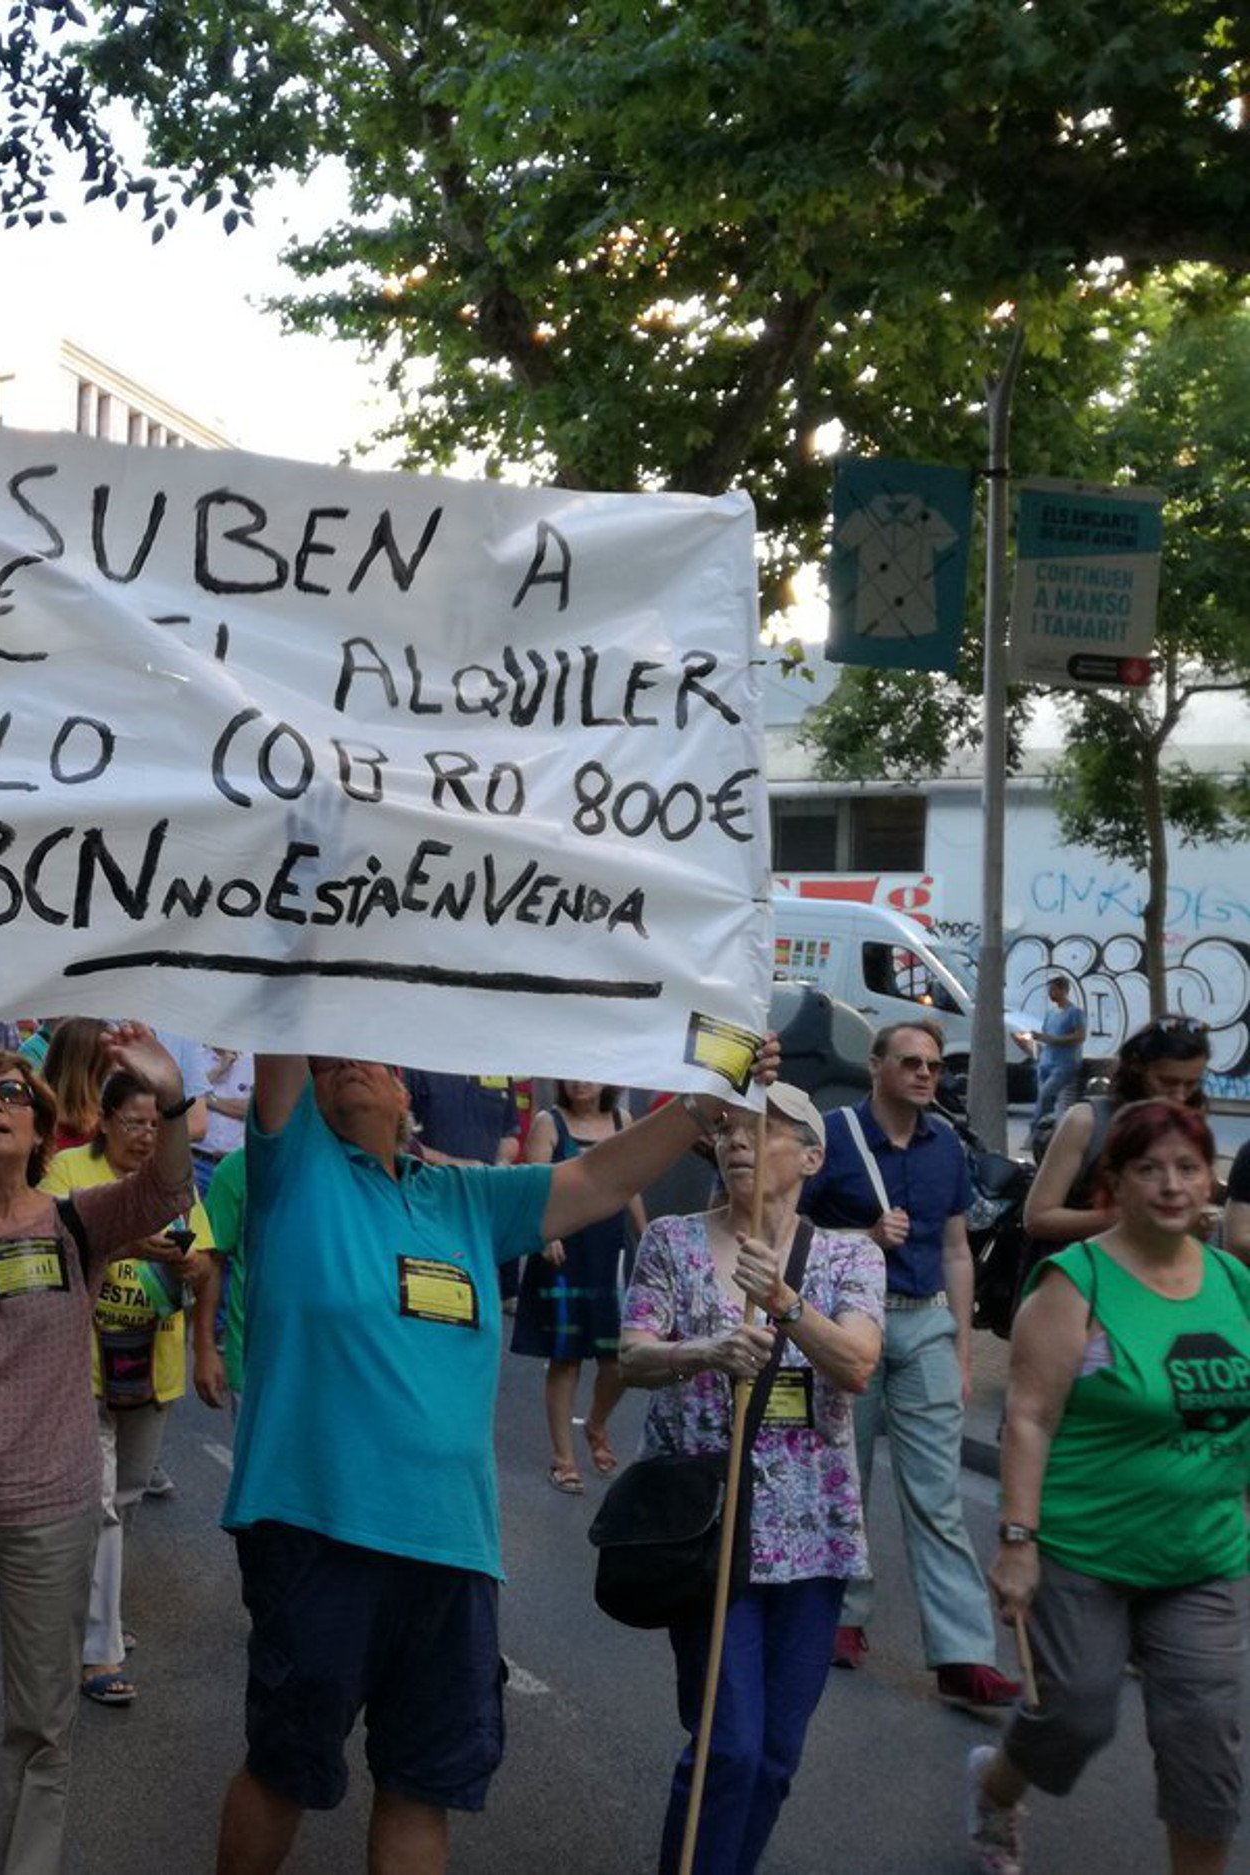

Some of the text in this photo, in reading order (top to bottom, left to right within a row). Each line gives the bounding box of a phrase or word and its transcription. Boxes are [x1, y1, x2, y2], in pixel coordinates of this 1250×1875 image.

[8, 465, 442, 595] SUBEN
[512, 520, 572, 611] A
[1034, 561, 1134, 590] CONTINUEN
[1033, 585, 1132, 616] A MANSO
[1041, 613, 1128, 642] TAMARIT
[334, 636, 742, 730] ALQUILER
[212, 708, 525, 816] COBRO
[573, 760, 759, 842] 800€
[1170, 1357, 1250, 1391] STOP
